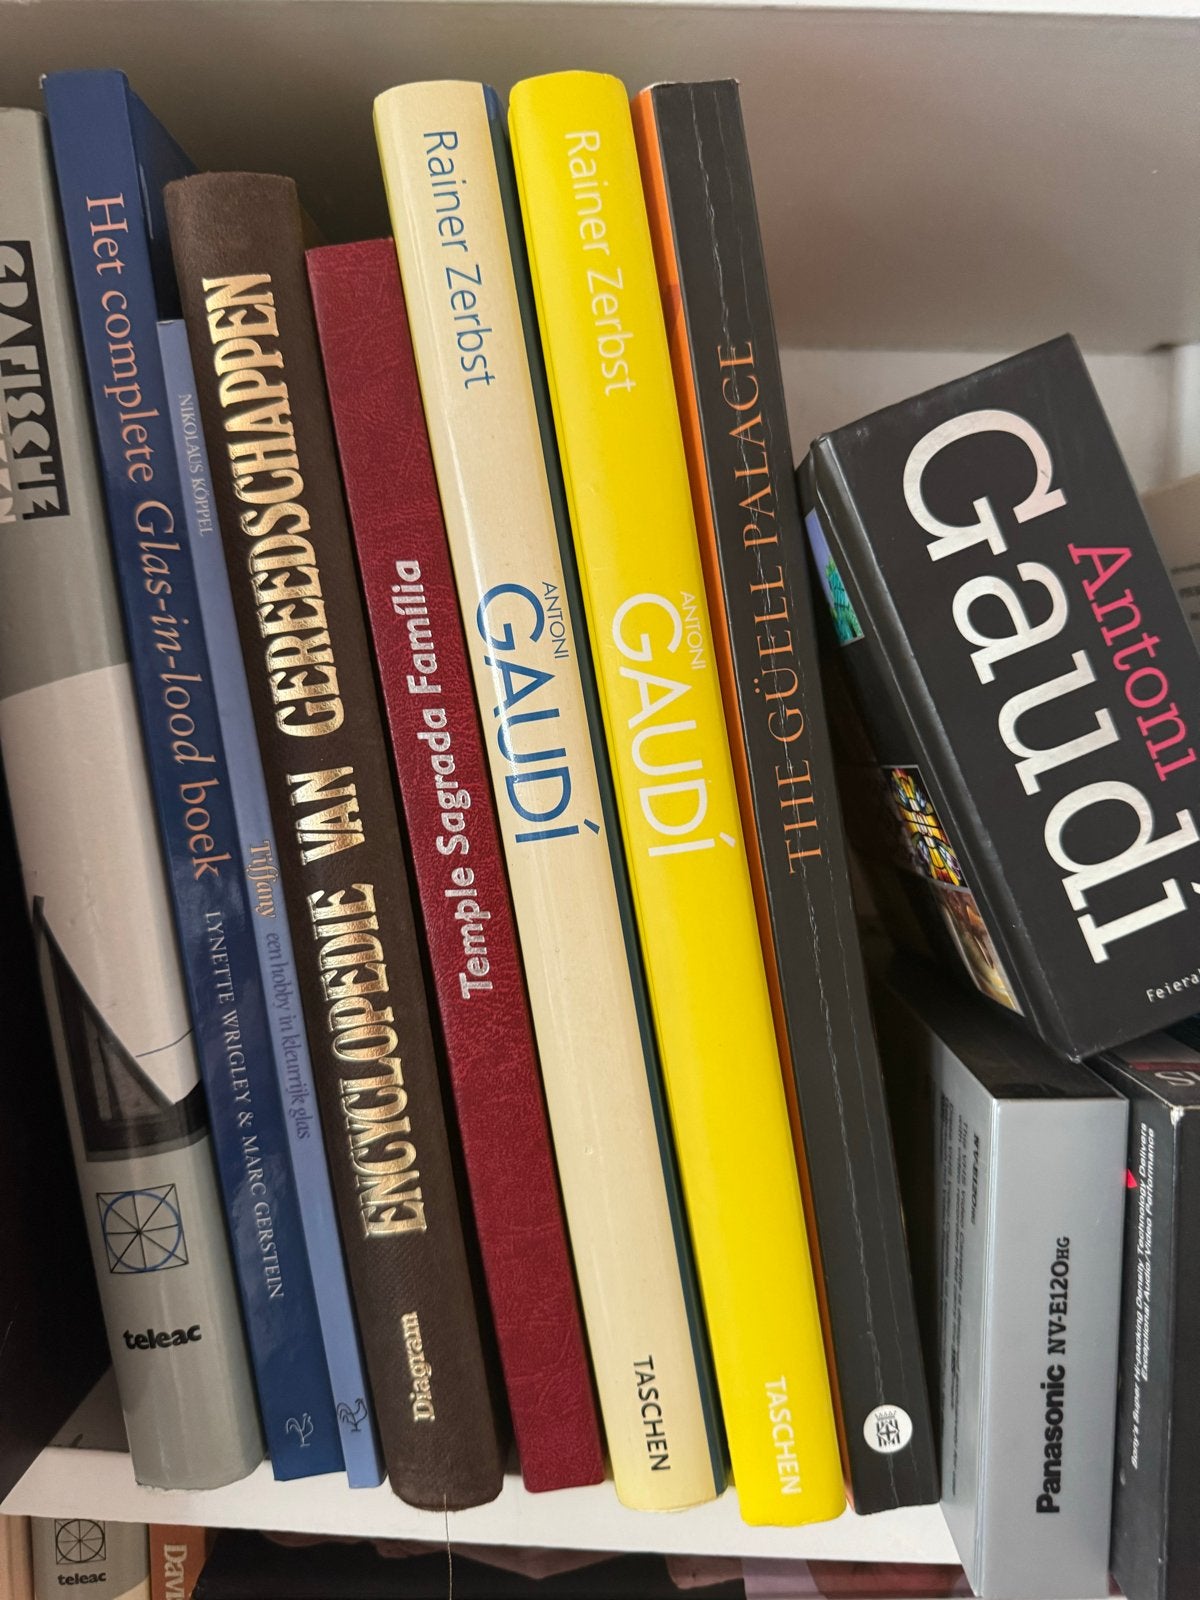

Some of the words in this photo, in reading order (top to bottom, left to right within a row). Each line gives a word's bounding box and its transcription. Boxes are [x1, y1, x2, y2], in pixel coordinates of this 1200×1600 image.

[86, 193, 128, 276] Het
[423, 131, 468, 252] Rainer
[564, 130, 610, 256] Rainer
[445, 263, 495, 390] Zerbst
[586, 267, 637, 396] Zerbst
[101, 290, 160, 483] complete
[178, 394, 203, 474] NIKOLAUS
[192, 478, 213, 536] KÖPPEL
[717, 341, 779, 551] PALACE
[202, 273, 345, 737] GEREEDSCHAPPEN
[135, 501, 216, 765] Glas-in-lood
[391, 560, 442, 694] Família
[542, 581, 569, 659] ANTONI
[680, 591, 706, 670] ANTONI
[750, 565, 804, 743] GÜELL
[476, 583, 600, 844] GAUDÍ
[612, 592, 736, 857] GAUDÍ
[180, 778, 232, 881] boek
[286, 766, 366, 866] VAN
[416, 708, 471, 856] Sagrada
[775, 759, 822, 874] THE
[245, 840, 279, 919] Tiffany
[444, 867, 493, 1000] Temple
[204, 911, 234, 1004] LYNETTE
[266, 932, 283, 960] een
[268, 961, 292, 1012] hobby
[1146, 968, 1200, 1003] Feiera
[222, 1009, 251, 1103] WRIGLEY
[279, 1014, 297, 1036] in
[307, 883, 427, 1239] ENCYCLOPEDIE
[237, 1111, 254, 1128] &
[242, 1135, 266, 1196] MARC
[288, 1107, 313, 1140] glas
[1138, 1122, 1148, 1177] Delivers
[254, 1202, 284, 1299] GERSTEIN
[1136, 1179, 1147, 1255] Technology
[1140, 1301, 1150, 1382] Exceptional
[1146, 1127, 1155, 1215] Performance
[123, 1324, 202, 1351] teleac
[401, 1311, 436, 1423] Diagram
[634, 1355, 671, 1471] TASCHEN
[765, 1375, 802, 1494] TASCHEN
[1036, 1364, 1066, 1514] Panasonic
[57, 1572, 107, 1586] teleac
